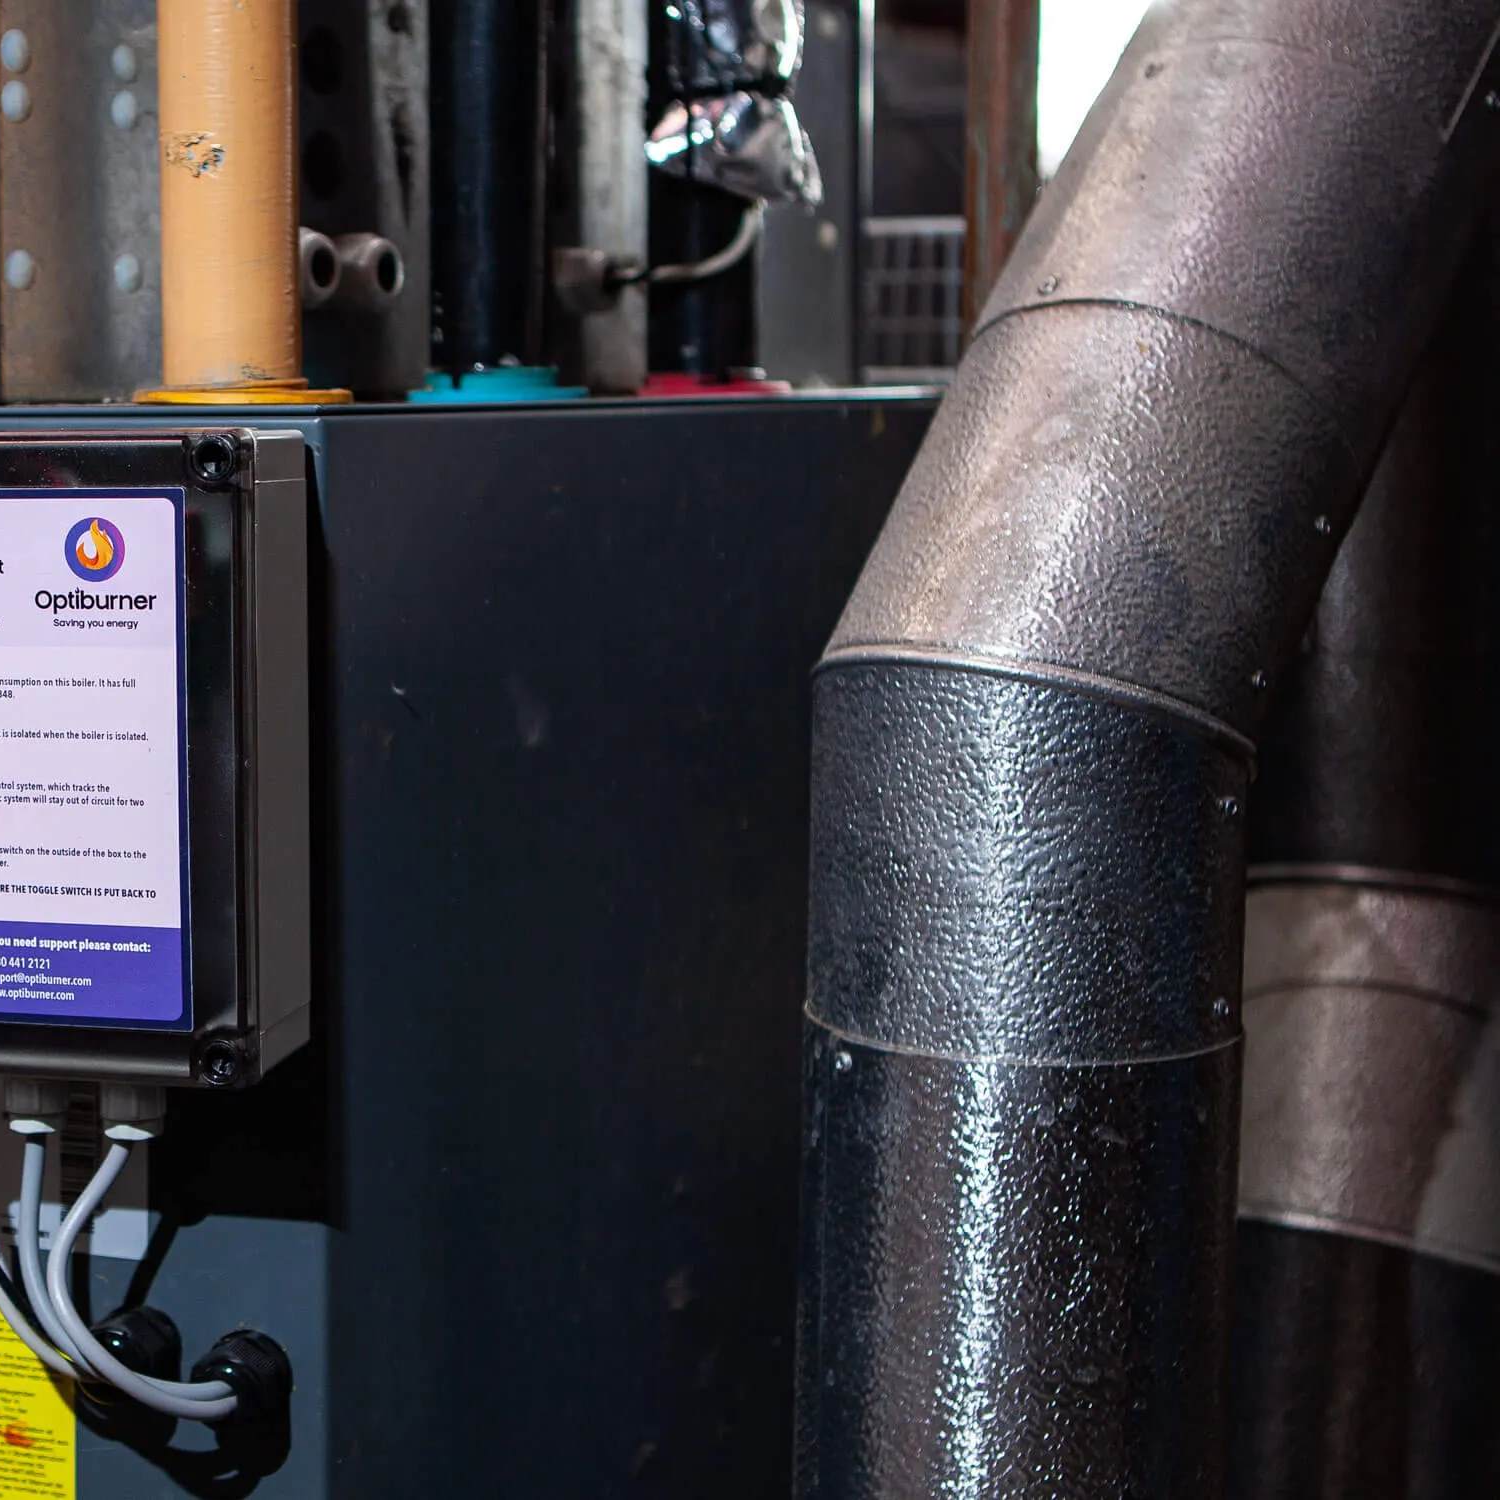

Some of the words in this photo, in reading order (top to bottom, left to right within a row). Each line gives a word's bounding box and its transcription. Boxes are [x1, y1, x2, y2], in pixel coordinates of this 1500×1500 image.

[34, 588, 157, 613] Optiburner
[52, 618, 85, 629] Saving
[86, 620, 104, 628] you
[106, 620, 139, 629] energy
[54, 677, 70, 686] this
[71, 678, 97, 687] boiler.
[98, 678, 105, 687] It
[106, 678, 121, 687] has
[122, 678, 136, 688] full
[2, 728, 9, 738] is
[10, 729, 41, 738] isolated
[42, 730, 65, 739] when
[66, 730, 80, 739] the
[81, 730, 105, 740] boiler
[106, 731, 113, 740] is
[114, 731, 148, 741] isolated.
[10, 884, 26, 893] THE
[27, 885, 59, 894] TOGGLE
[60, 886, 92, 896] SWITCH
[94, 887, 102, 896] IS
[104, 888, 120, 897] PUT
[121, 889, 144, 898] BACK
[144, 889, 156, 898] TO
[12, 936, 37, 947] need
[38, 939, 78, 951] support
[78, 938, 111, 952] please
[112, 942, 151, 952] contact:
[8, 957, 25, 968] 441
[27, 957, 50, 969] 2121
